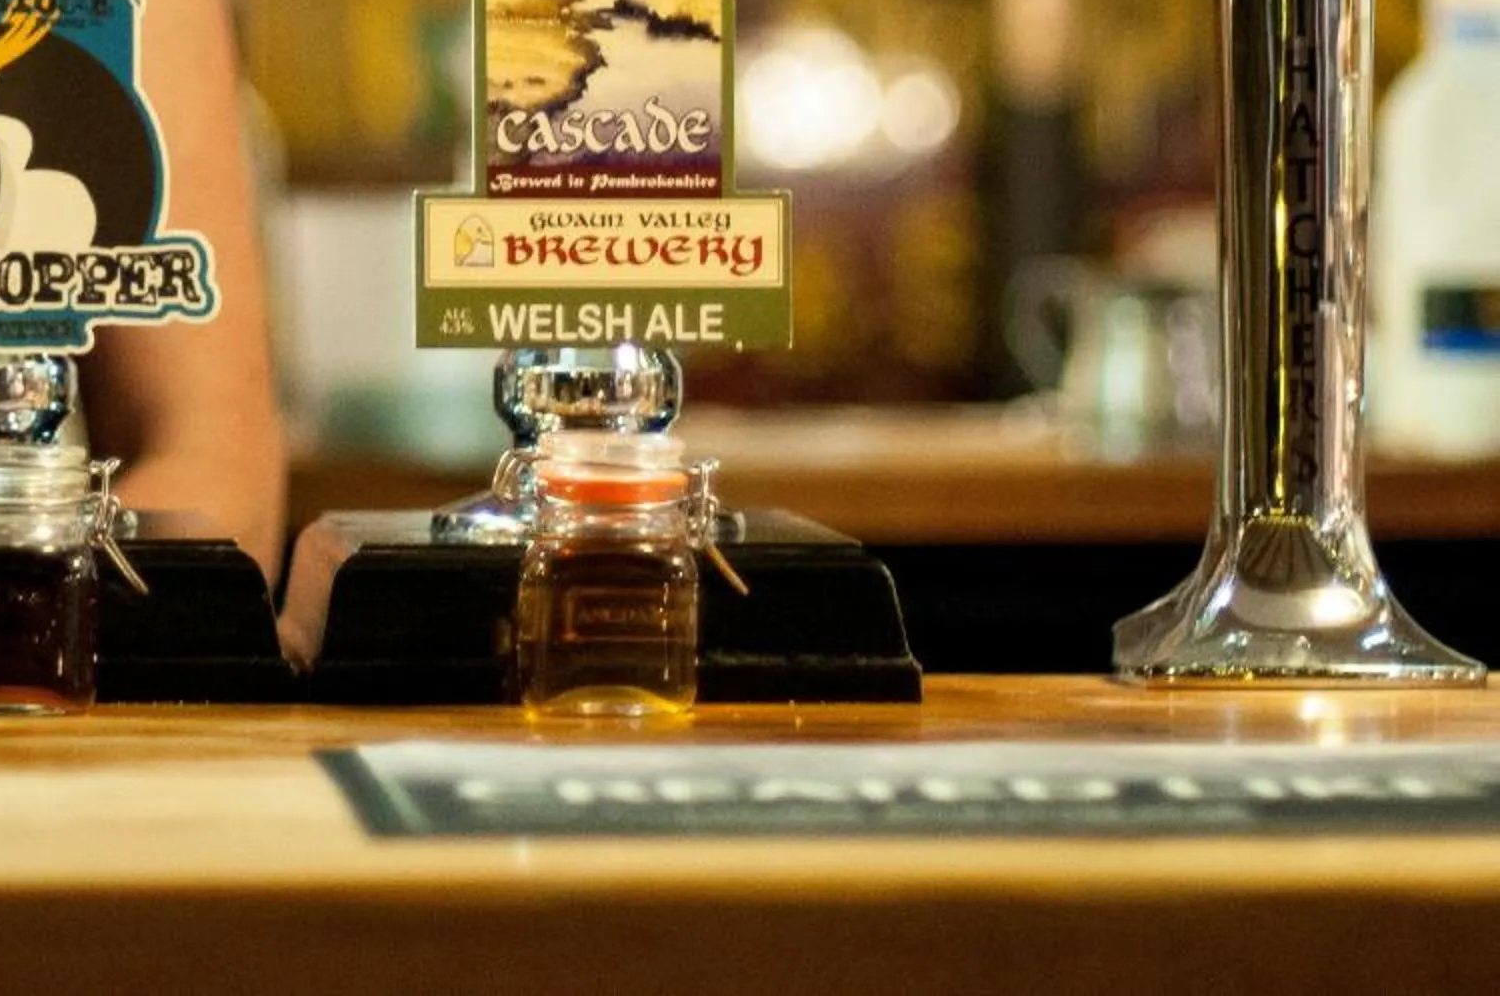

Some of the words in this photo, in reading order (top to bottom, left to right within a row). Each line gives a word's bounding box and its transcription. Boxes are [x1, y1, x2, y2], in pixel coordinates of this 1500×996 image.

[568, 173, 585, 188] in
[489, 303, 633, 342] WELSH
[644, 303, 725, 342] ALE
